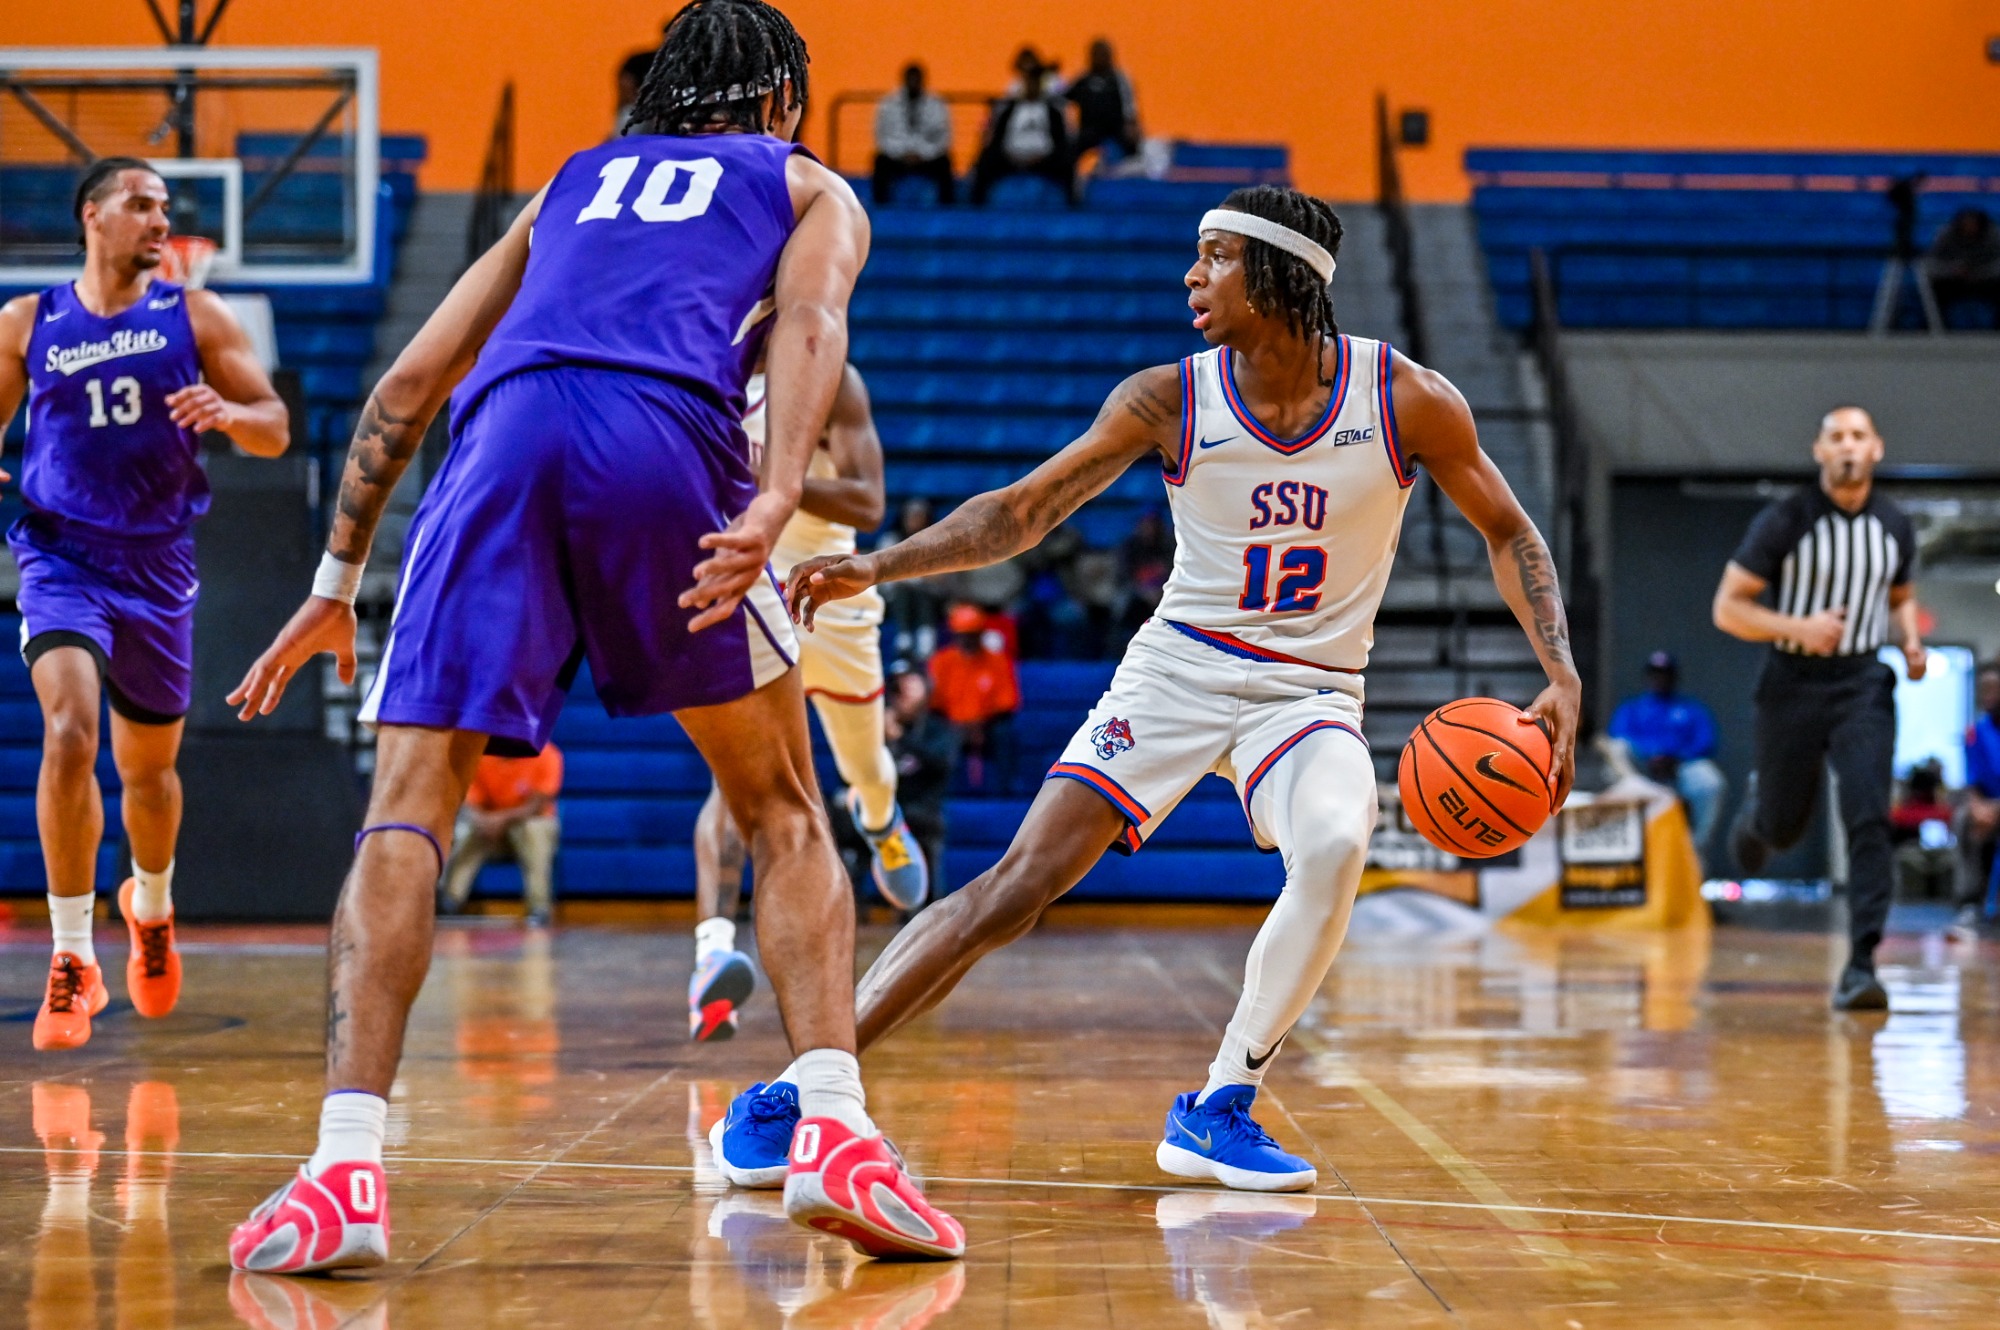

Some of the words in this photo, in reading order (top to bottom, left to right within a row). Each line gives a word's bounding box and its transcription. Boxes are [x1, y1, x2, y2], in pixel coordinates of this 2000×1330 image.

[575, 156, 724, 225] 10
[46, 340, 113, 376] Spring
[111, 329, 168, 354] Hill
[85, 376, 142, 428] 13
[1250, 480, 1329, 531] SSU
[1238, 544, 1329, 613] 12
[1438, 787, 1508, 847] ELITE
[793, 1123, 821, 1164] 0
[350, 1168, 377, 1213] 0
